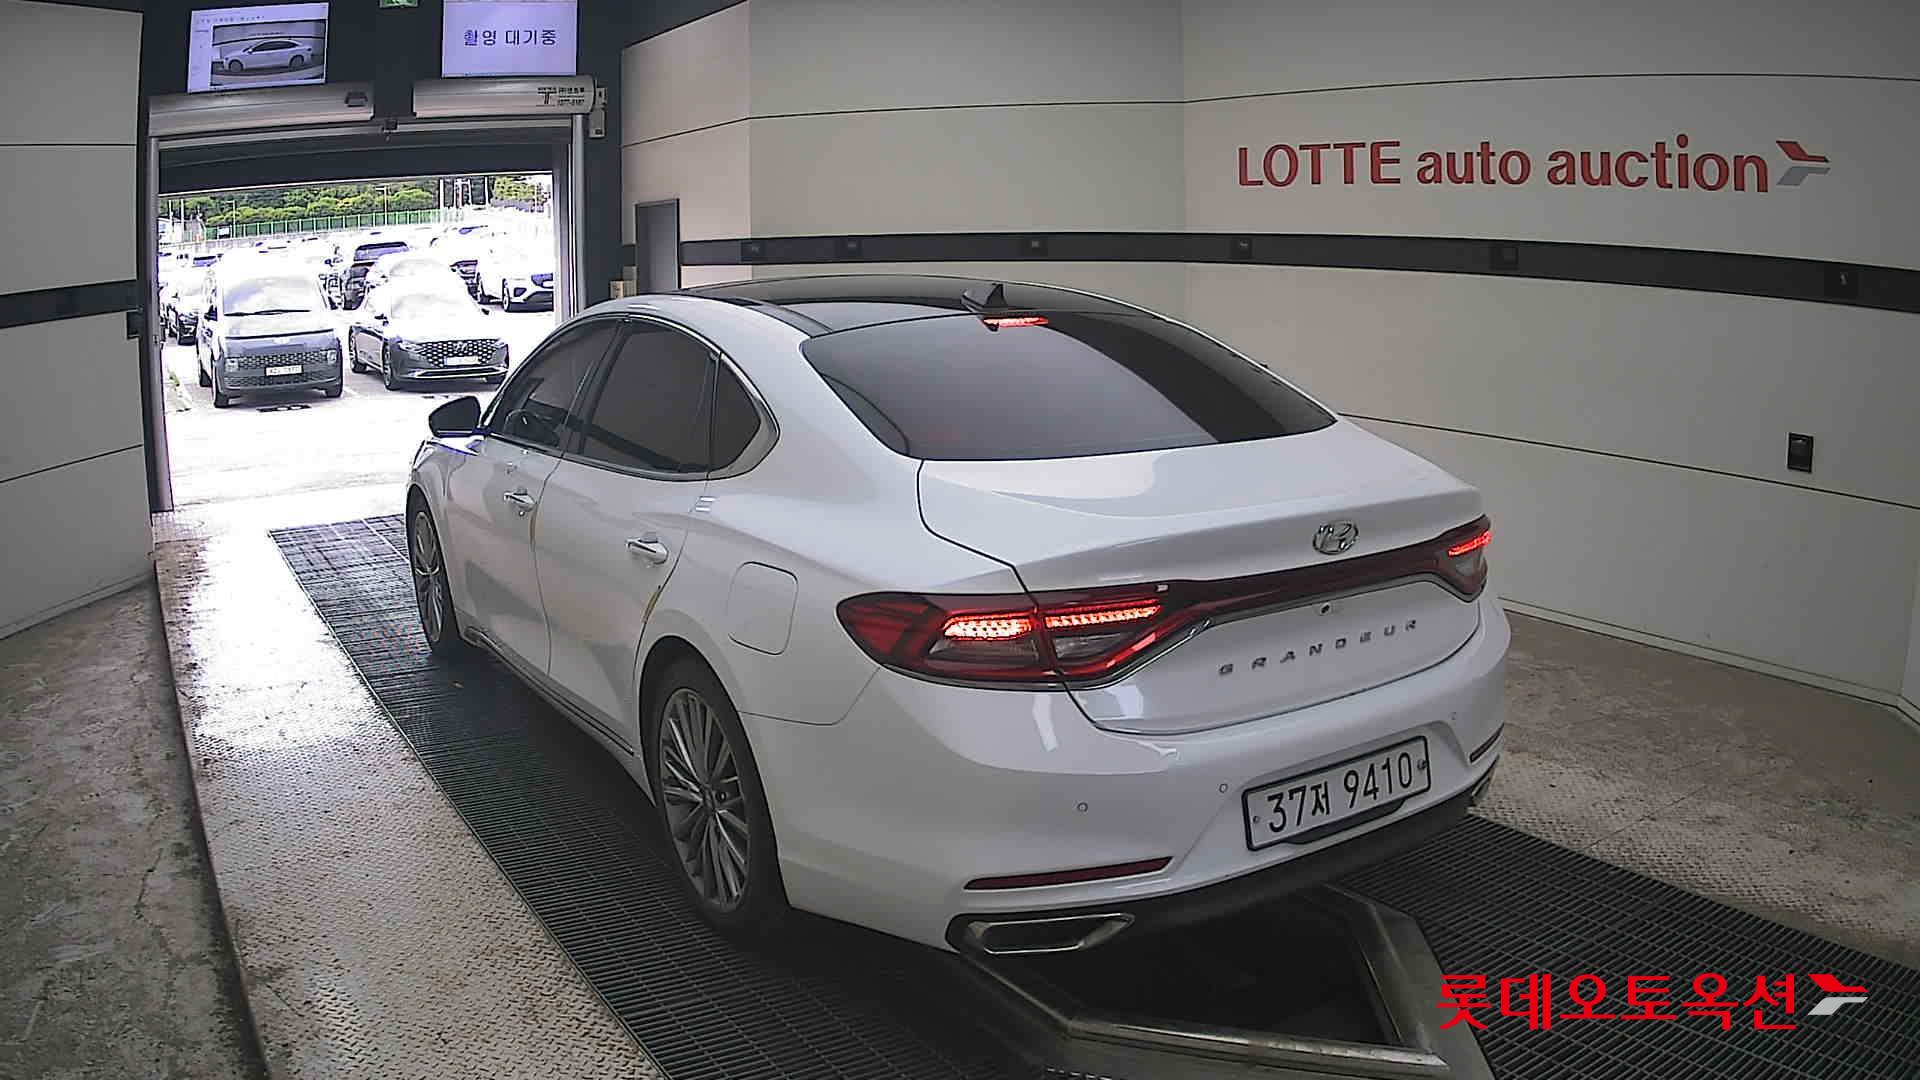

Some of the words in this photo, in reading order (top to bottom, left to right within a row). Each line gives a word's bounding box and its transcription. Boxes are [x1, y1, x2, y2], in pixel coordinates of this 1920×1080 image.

[505, 29, 556, 46] 대기중
[1238, 141, 1400, 187] LOTTE
[1416, 141, 1531, 185] auto
[1547, 134, 1768, 192] auction
[1219, 619, 1417, 676] GRANDEUR
[1267, 781, 1330, 833] 37저
[1343, 752, 1413, 809] 9410
